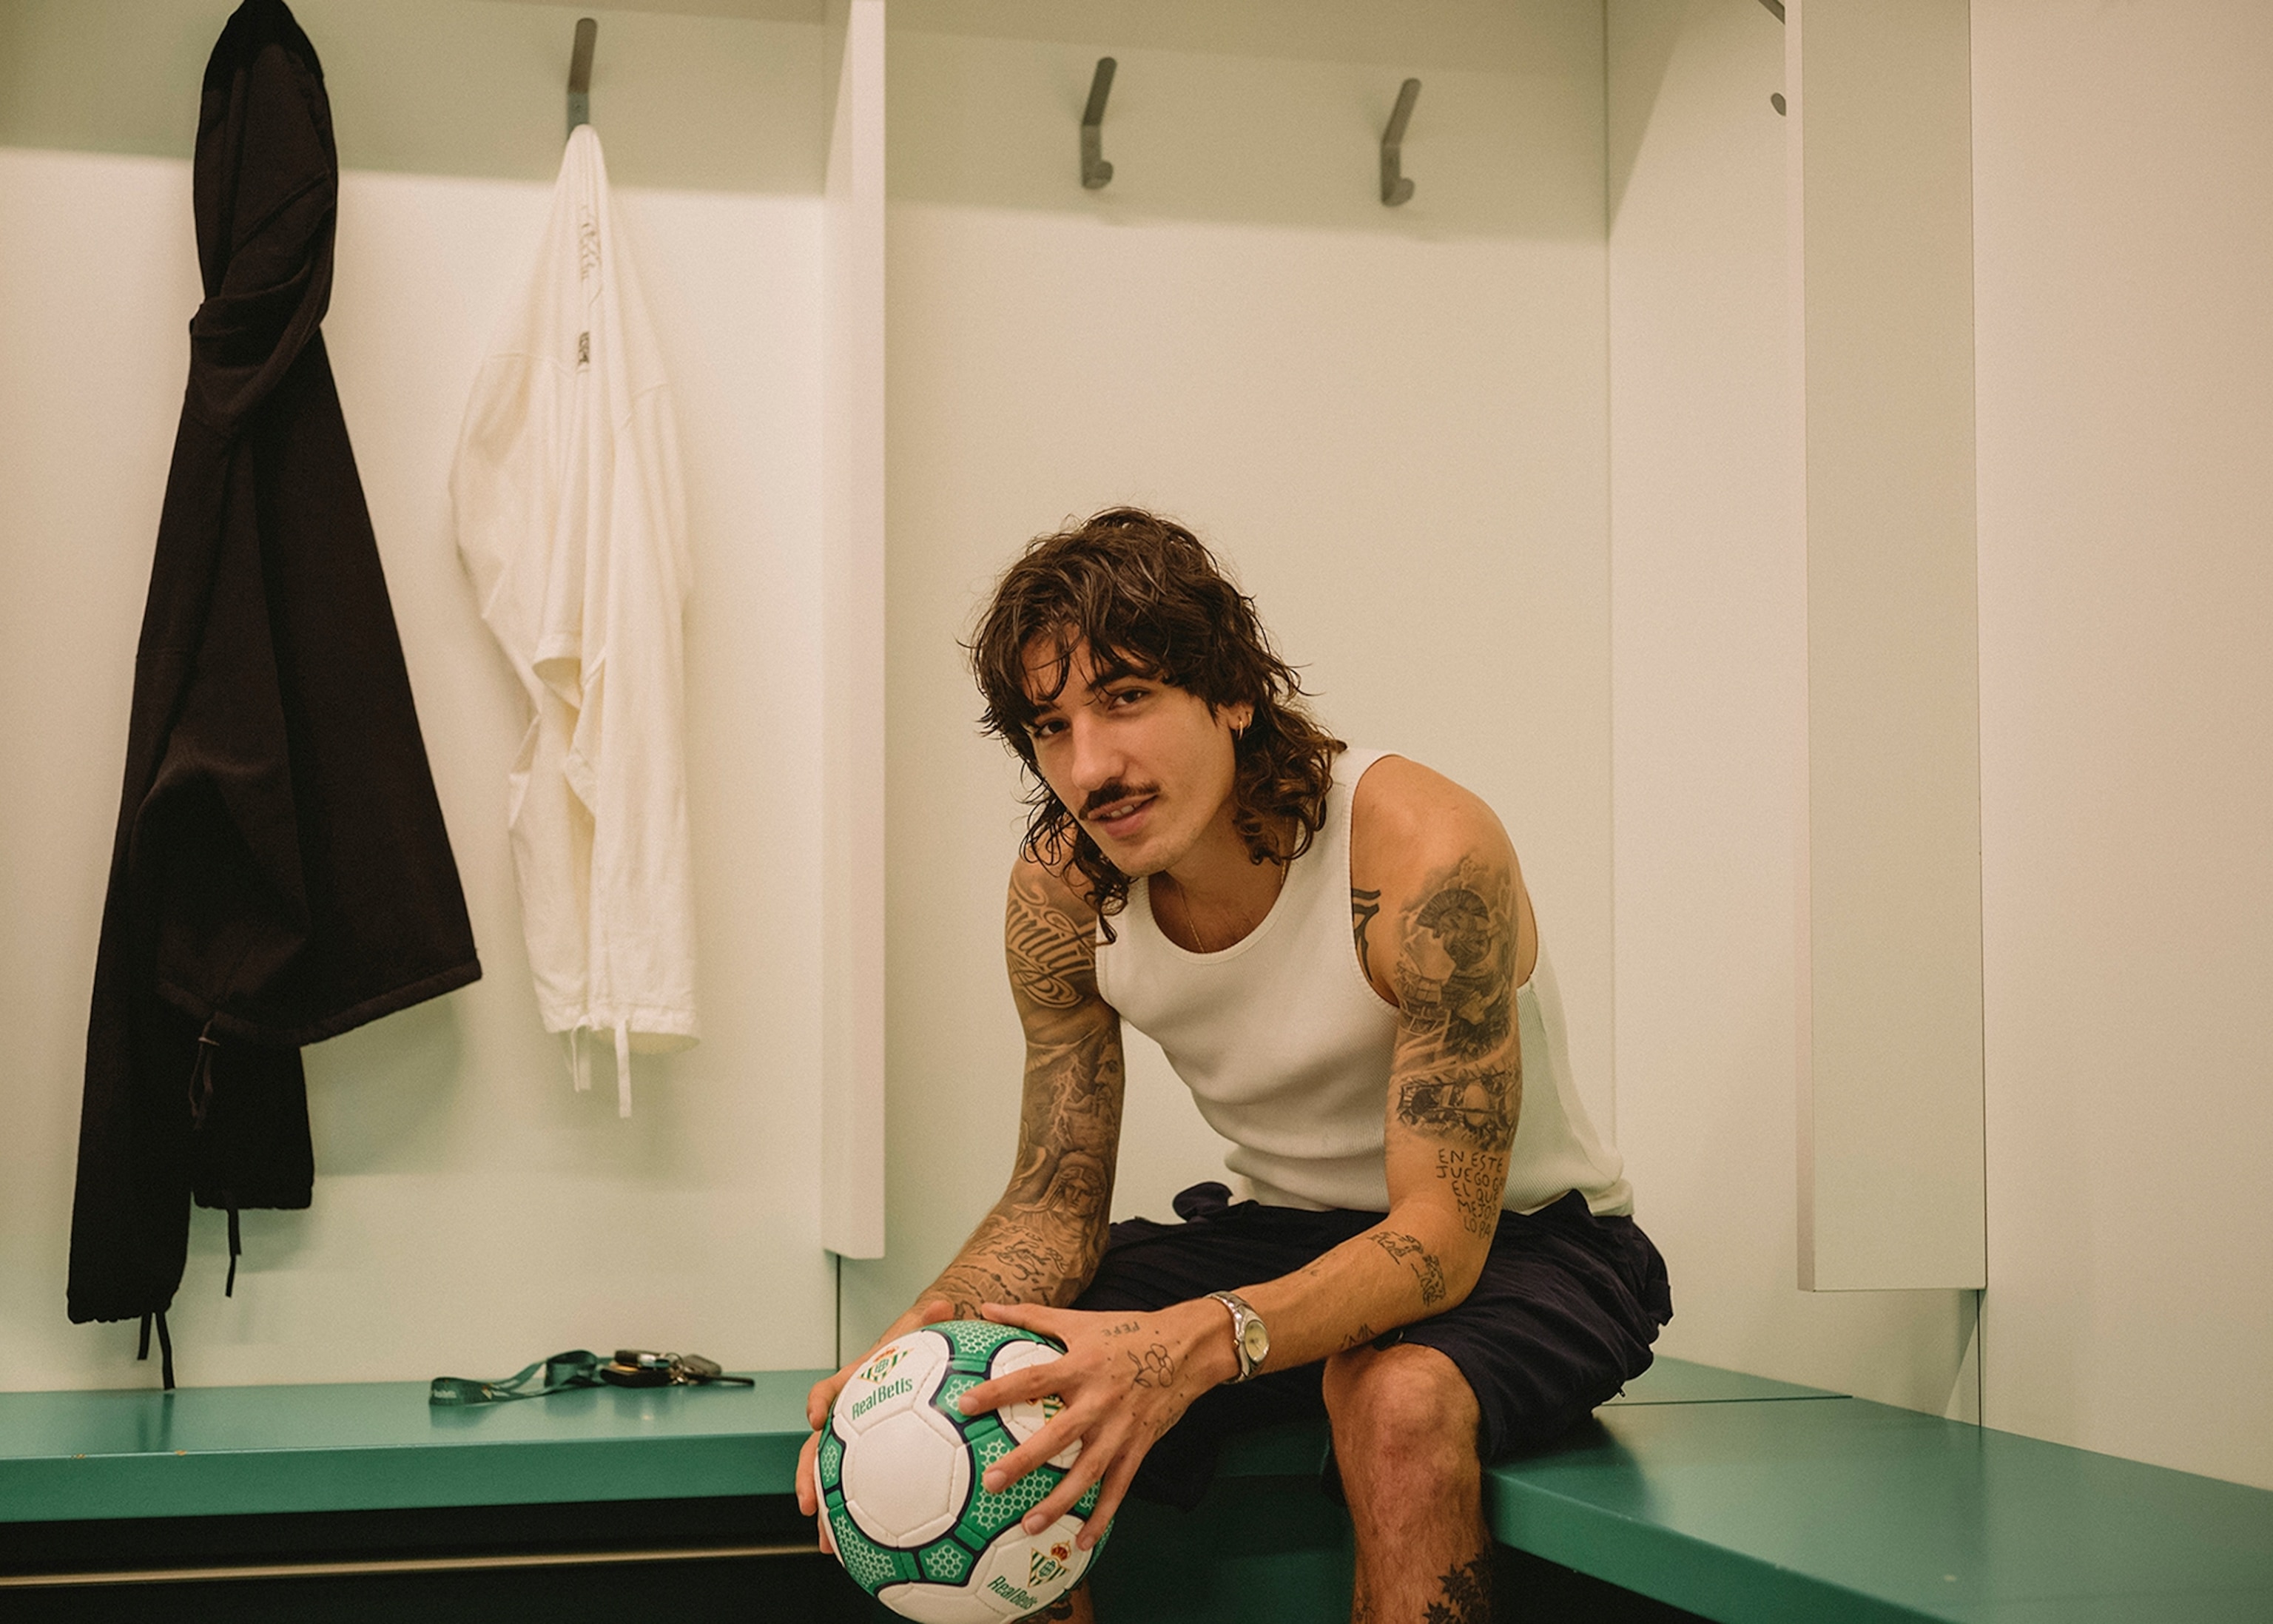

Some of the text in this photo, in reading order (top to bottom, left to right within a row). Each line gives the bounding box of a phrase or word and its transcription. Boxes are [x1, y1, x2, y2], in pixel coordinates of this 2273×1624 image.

[1438, 1148, 1503, 1173] EN ESTE
[1436, 1165, 1490, 1187] JUEGO
[1476, 1188, 1499, 1204] QUE
[1464, 1216, 1478, 1233] LO
